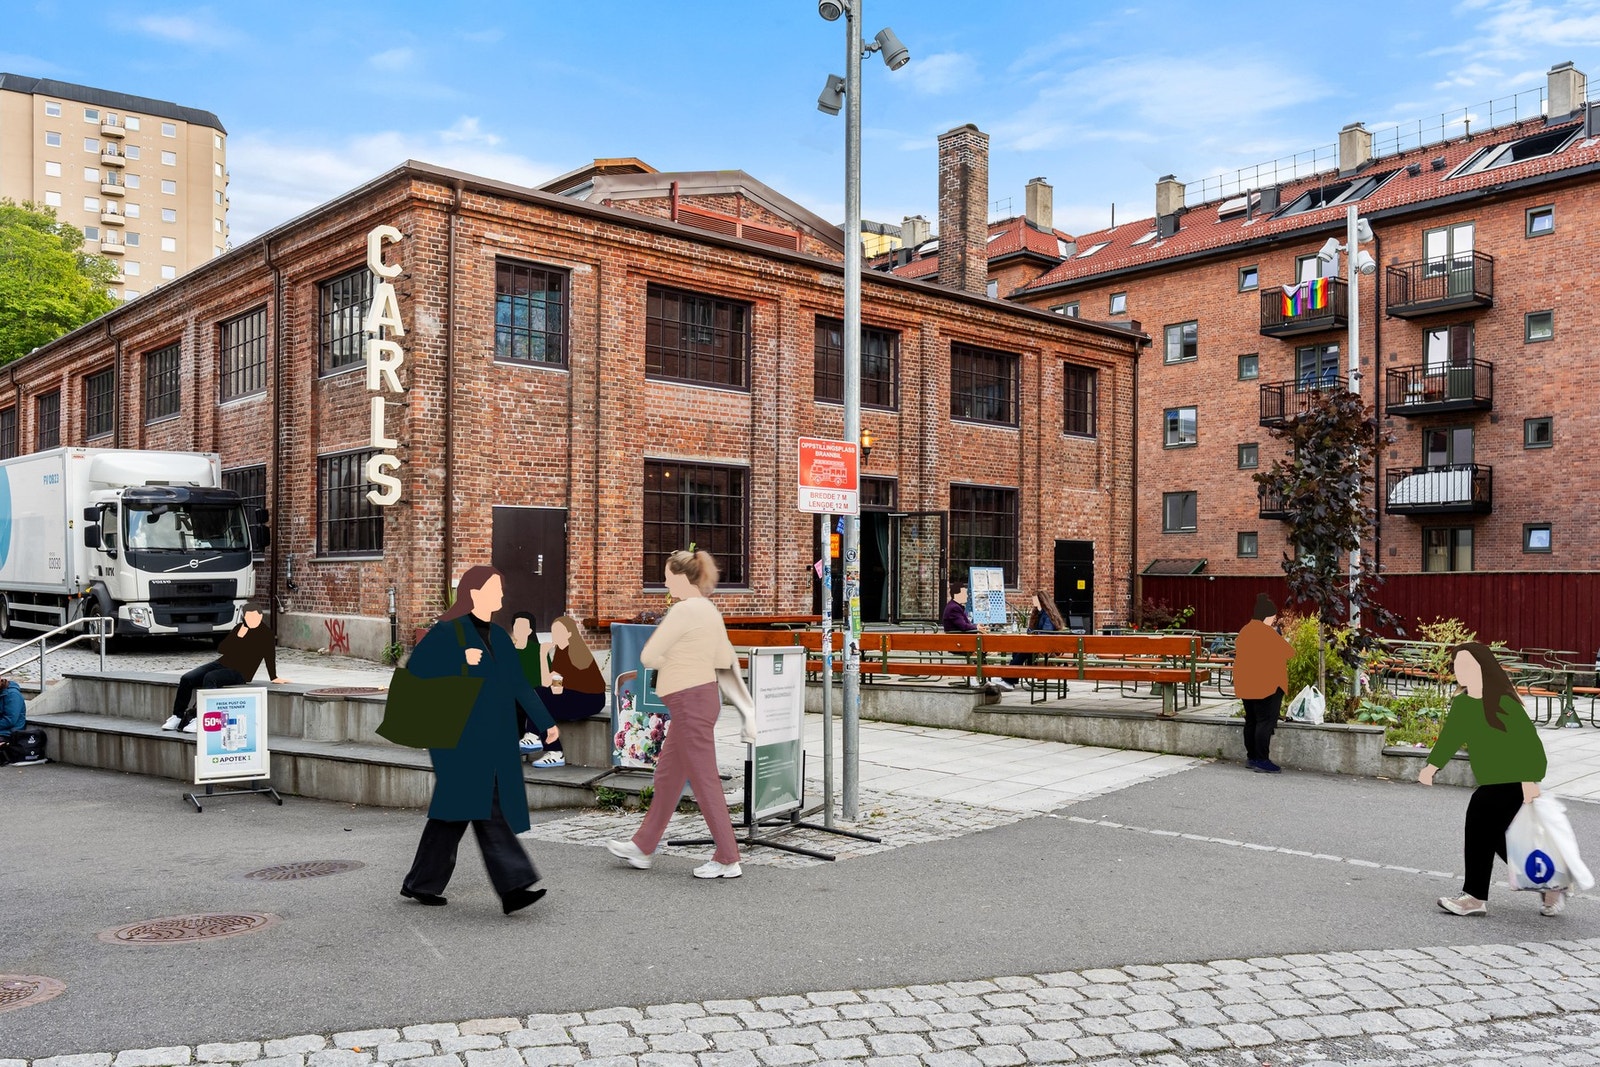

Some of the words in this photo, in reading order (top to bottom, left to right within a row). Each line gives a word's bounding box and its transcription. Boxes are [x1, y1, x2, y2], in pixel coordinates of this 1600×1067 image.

[365, 224, 405, 506] CARLS
[801, 442, 855, 454] OPPSTILLINGSPLASS
[815, 450, 842, 458] BRANNBIL
[810, 492, 836, 500] BREDDE
[808, 500, 834, 508] LENGDE
[204, 718, 222, 726] 50%
